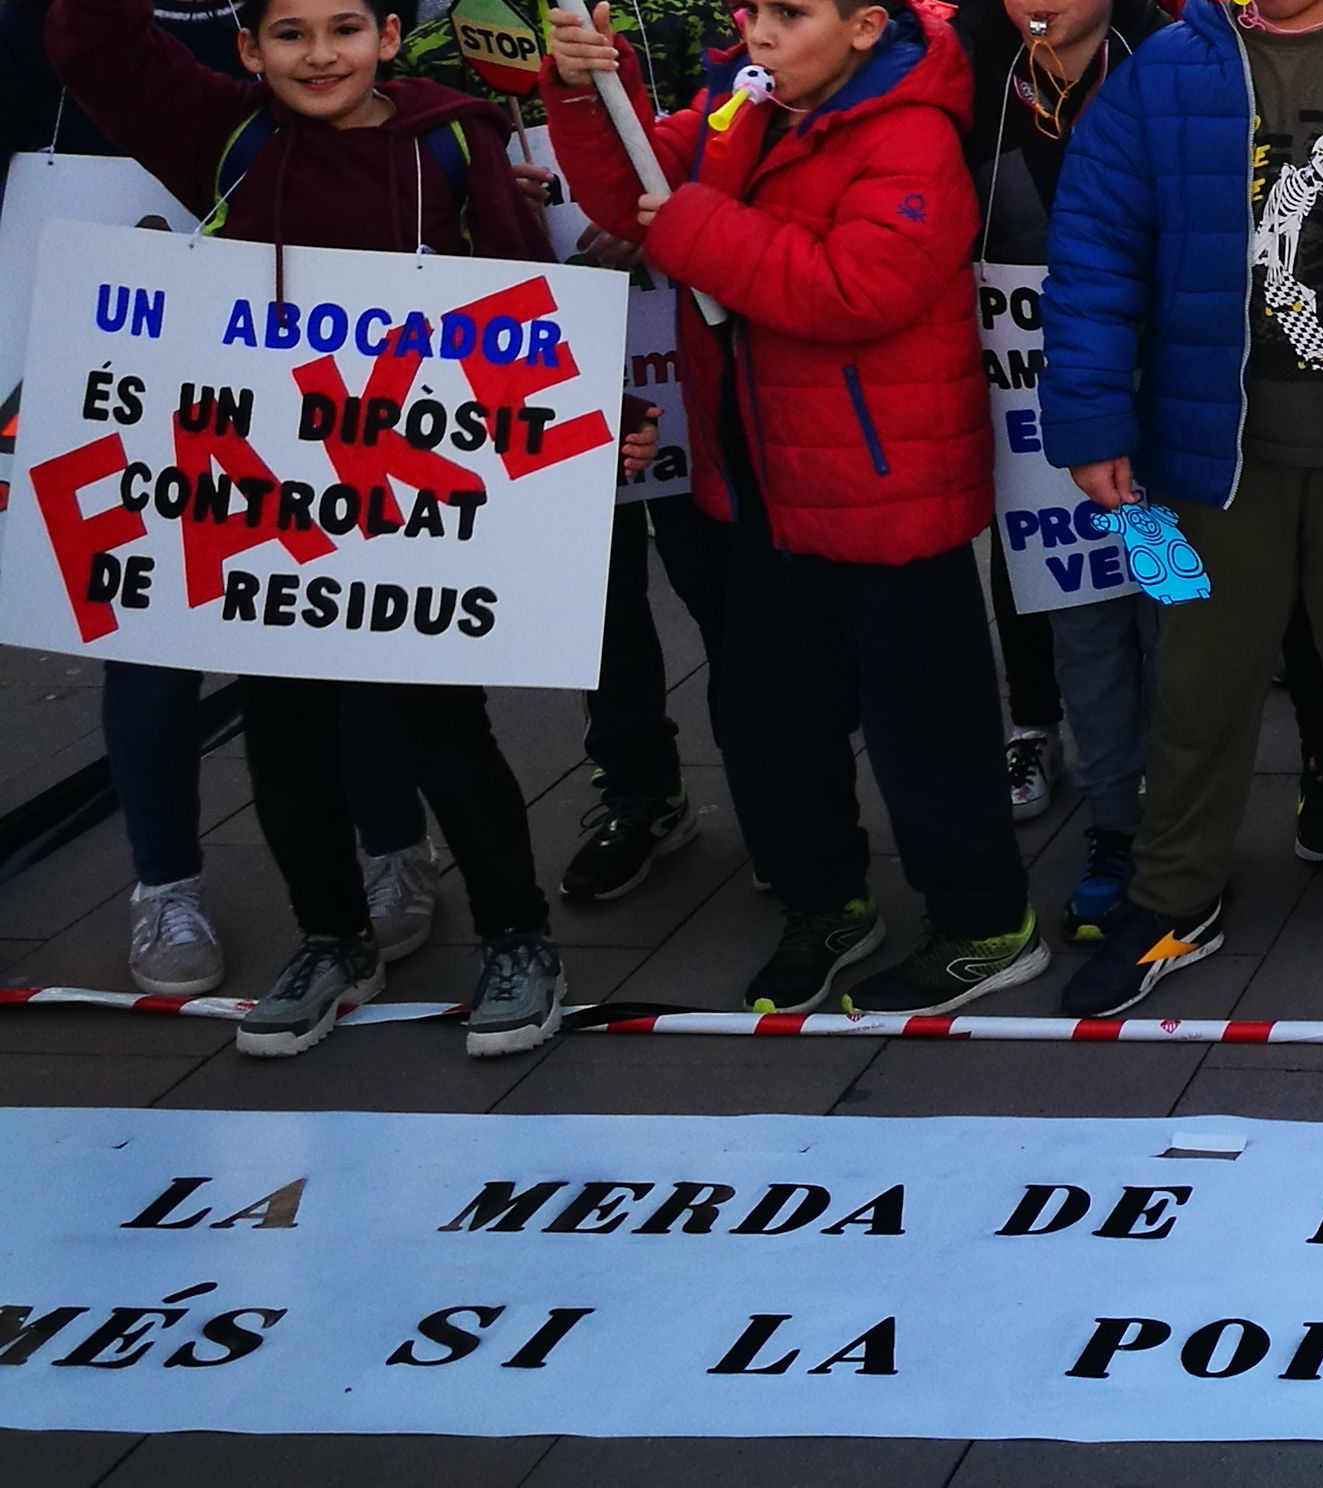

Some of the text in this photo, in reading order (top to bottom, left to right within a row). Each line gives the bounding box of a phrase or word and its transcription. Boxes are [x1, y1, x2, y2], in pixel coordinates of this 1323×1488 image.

[460, 24, 536, 61] STOP
[95, 284, 562, 369] UN ABOCADOR
[83, 362, 556, 455] ÉS UN DIPÒSIT
[120, 461, 487, 541] CONTROLAT
[87, 552, 498, 638] DE RESIDUS
[1044, 546, 1137, 593] VE
[121, 1176, 308, 1230] LA
[437, 1180, 906, 1237] MERDA
[994, 1183, 1194, 1240] DE
[0, 1281, 288, 1369] MÉS
[386, 1303, 597, 1370] SI
[705, 1314, 901, 1376] LA
